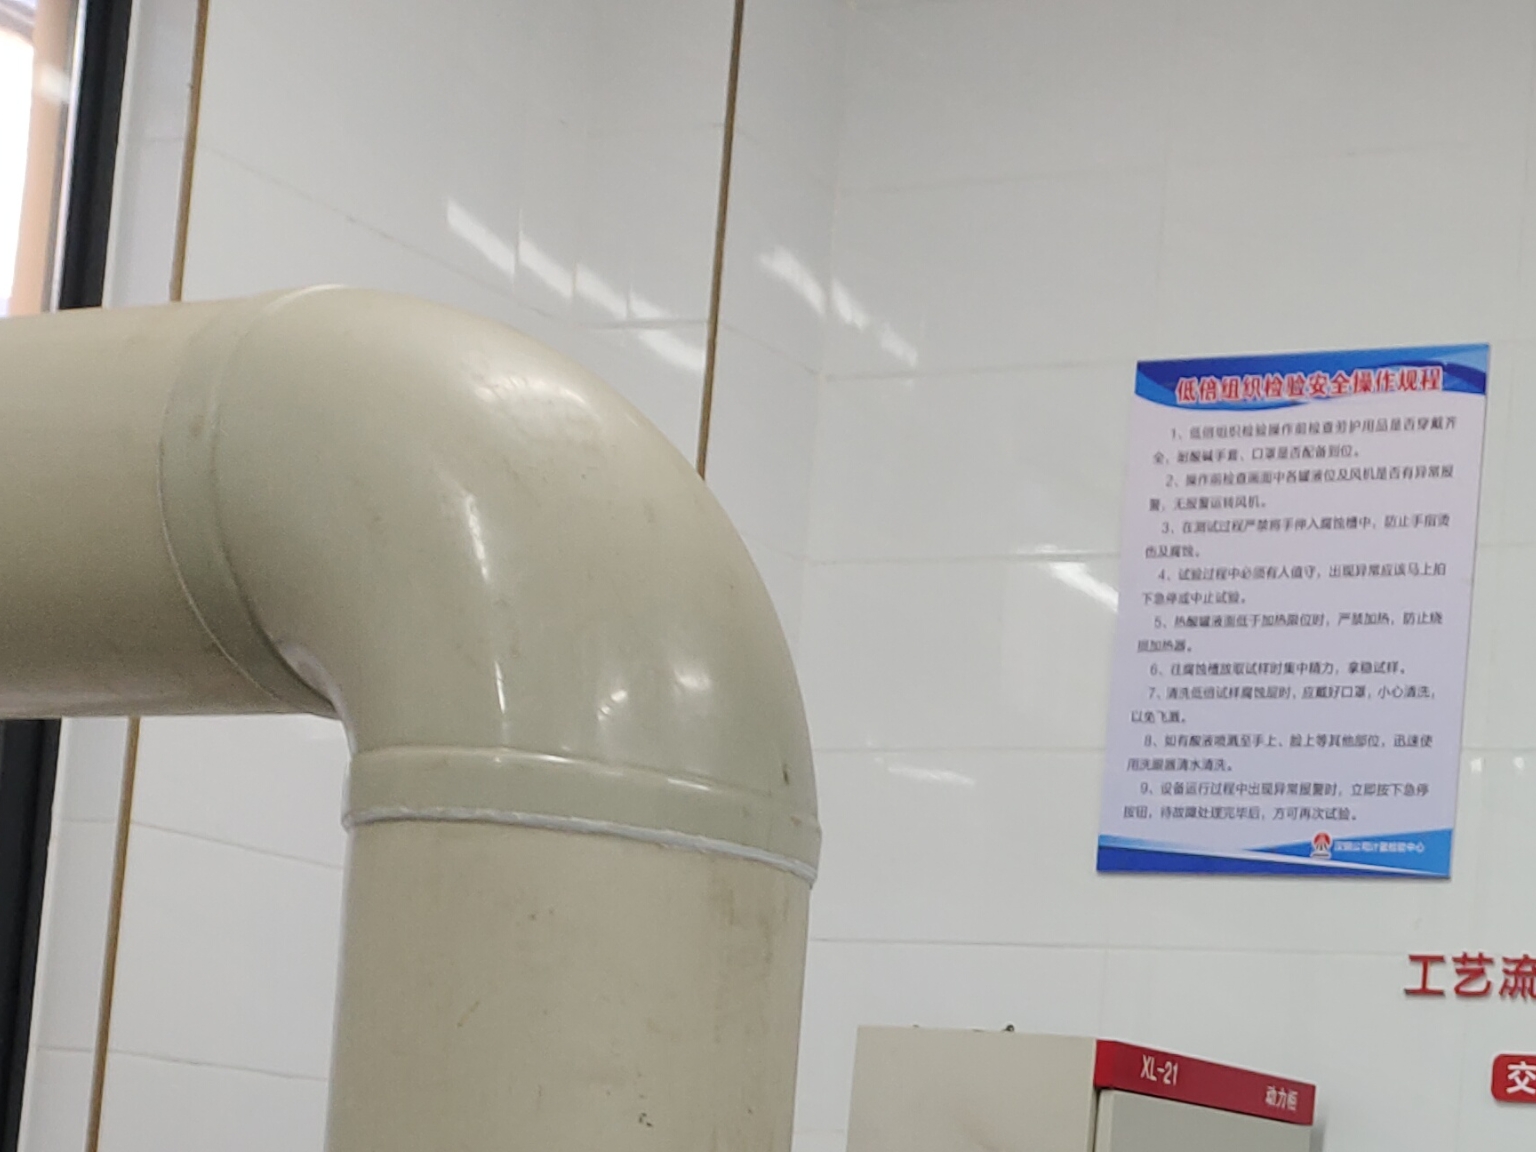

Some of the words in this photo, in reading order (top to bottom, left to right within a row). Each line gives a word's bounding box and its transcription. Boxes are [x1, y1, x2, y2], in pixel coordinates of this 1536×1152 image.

[1174, 365, 1443, 403] 低倍组织检验安全操作规程
[1140, 1054, 1178, 1086] XL-21
[1265, 1085, 1299, 1112] 动力柜
